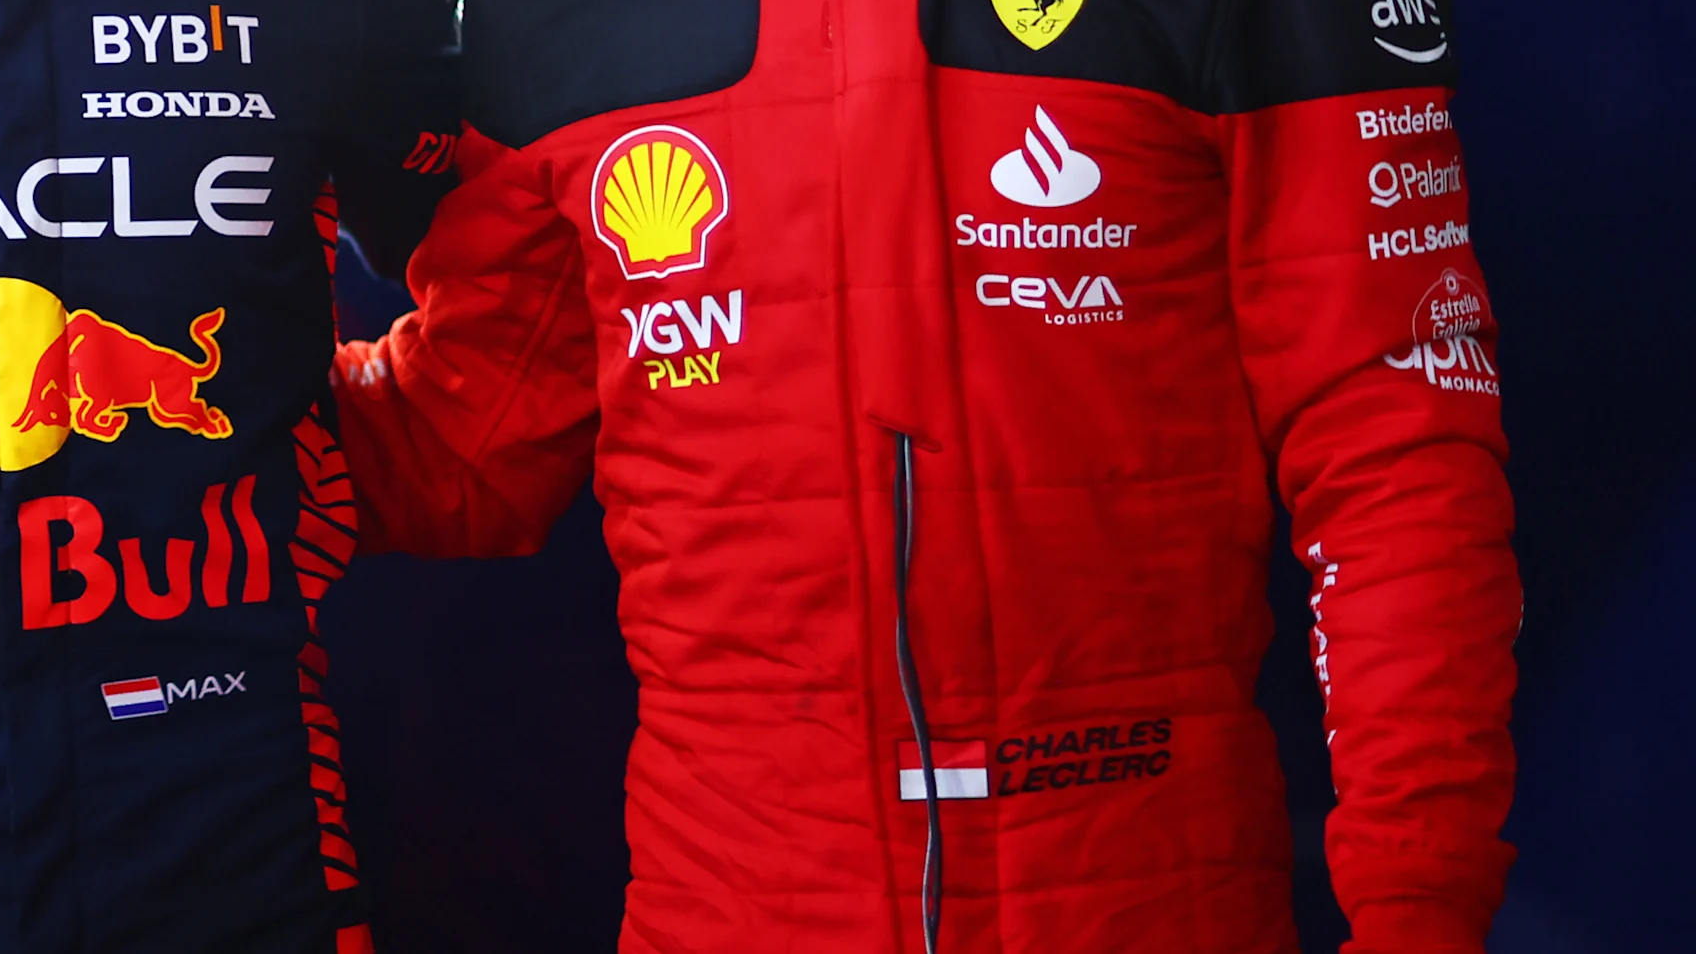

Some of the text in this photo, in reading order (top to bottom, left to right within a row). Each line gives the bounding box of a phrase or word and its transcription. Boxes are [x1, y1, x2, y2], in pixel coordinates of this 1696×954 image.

[92, 4, 260, 64] BYBIT
[82, 91, 277, 120] HONDA
[955, 214, 1138, 250] Santander
[1045, 309, 1124, 325] LOGISTICS
[643, 351, 721, 390] PLAY
[16, 473, 272, 631] Bull
[166, 671, 247, 704] MAX
[995, 717, 1173, 765] CHARLES
[997, 749, 1172, 797] LECLERC
